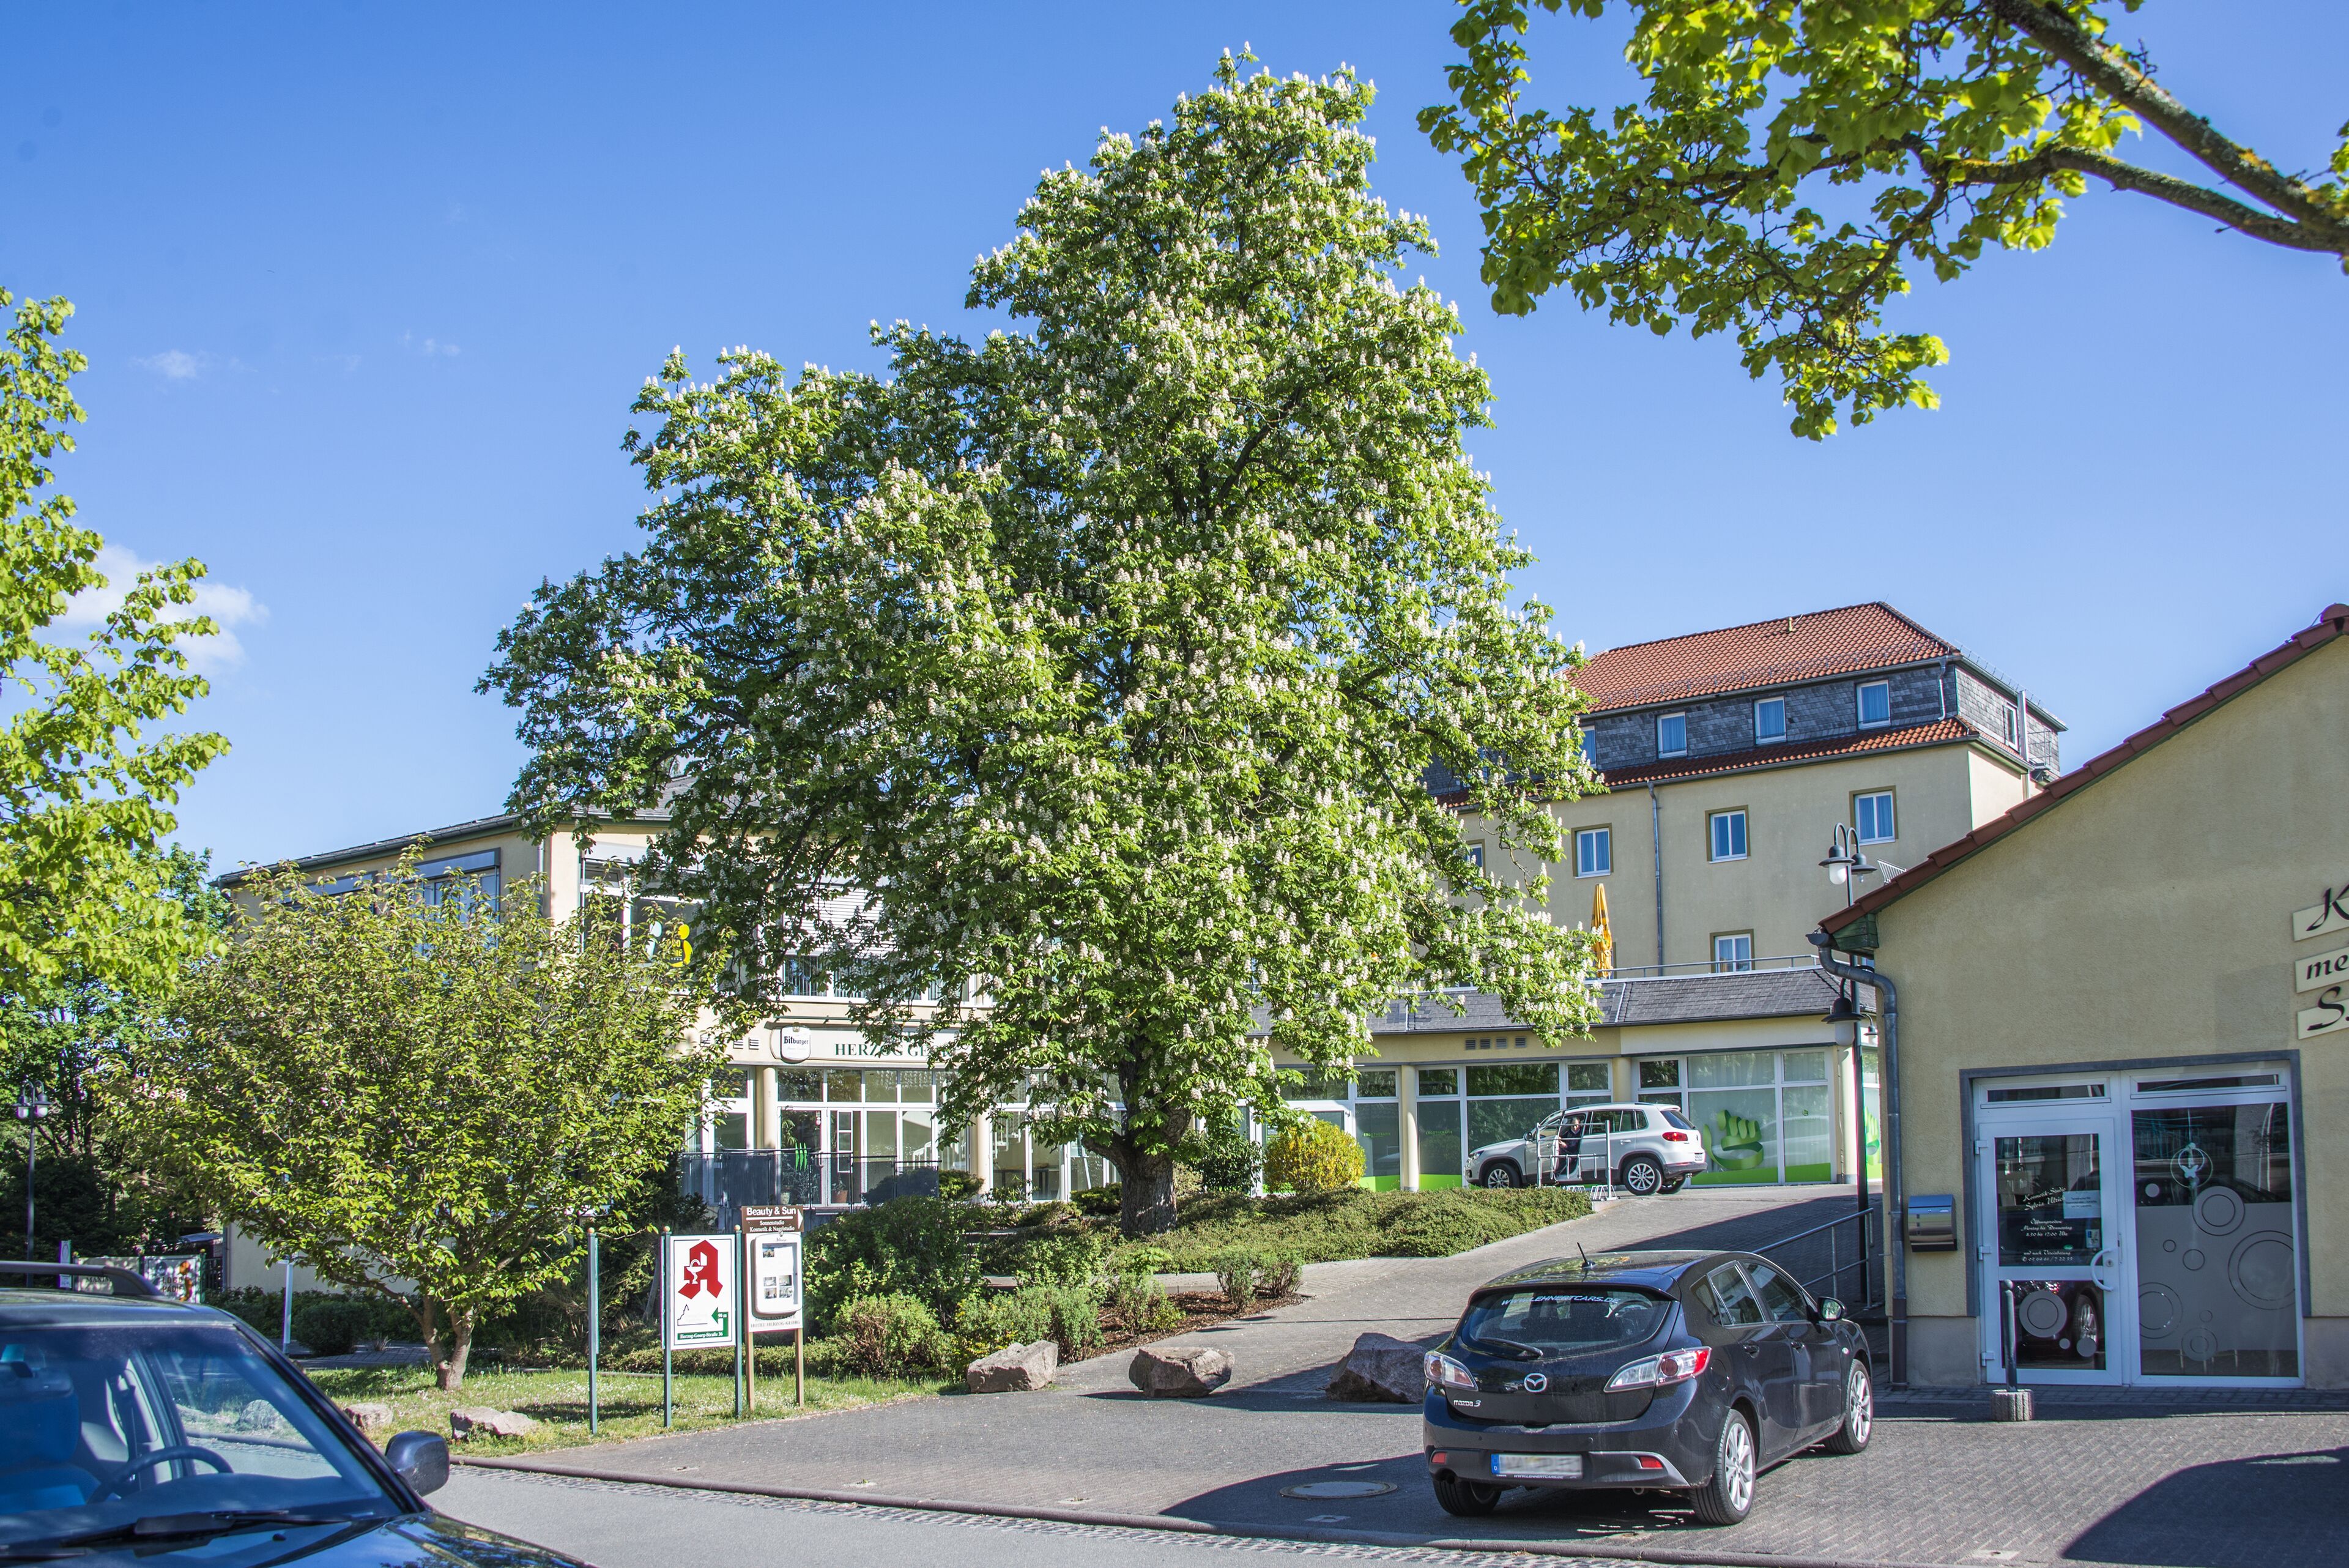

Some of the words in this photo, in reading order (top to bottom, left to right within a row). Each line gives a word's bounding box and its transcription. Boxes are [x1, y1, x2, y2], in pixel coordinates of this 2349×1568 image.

[784, 1036, 809, 1046] Bitburger
[835, 1043, 902, 1057] HERZOG
[746, 1206, 773, 1217] Beauty
[774, 1206, 781, 1215] &
[782, 1206, 796, 1215] Sun
[1501, 1295, 1622, 1306] WWW.LEHNERTCARS.DE
